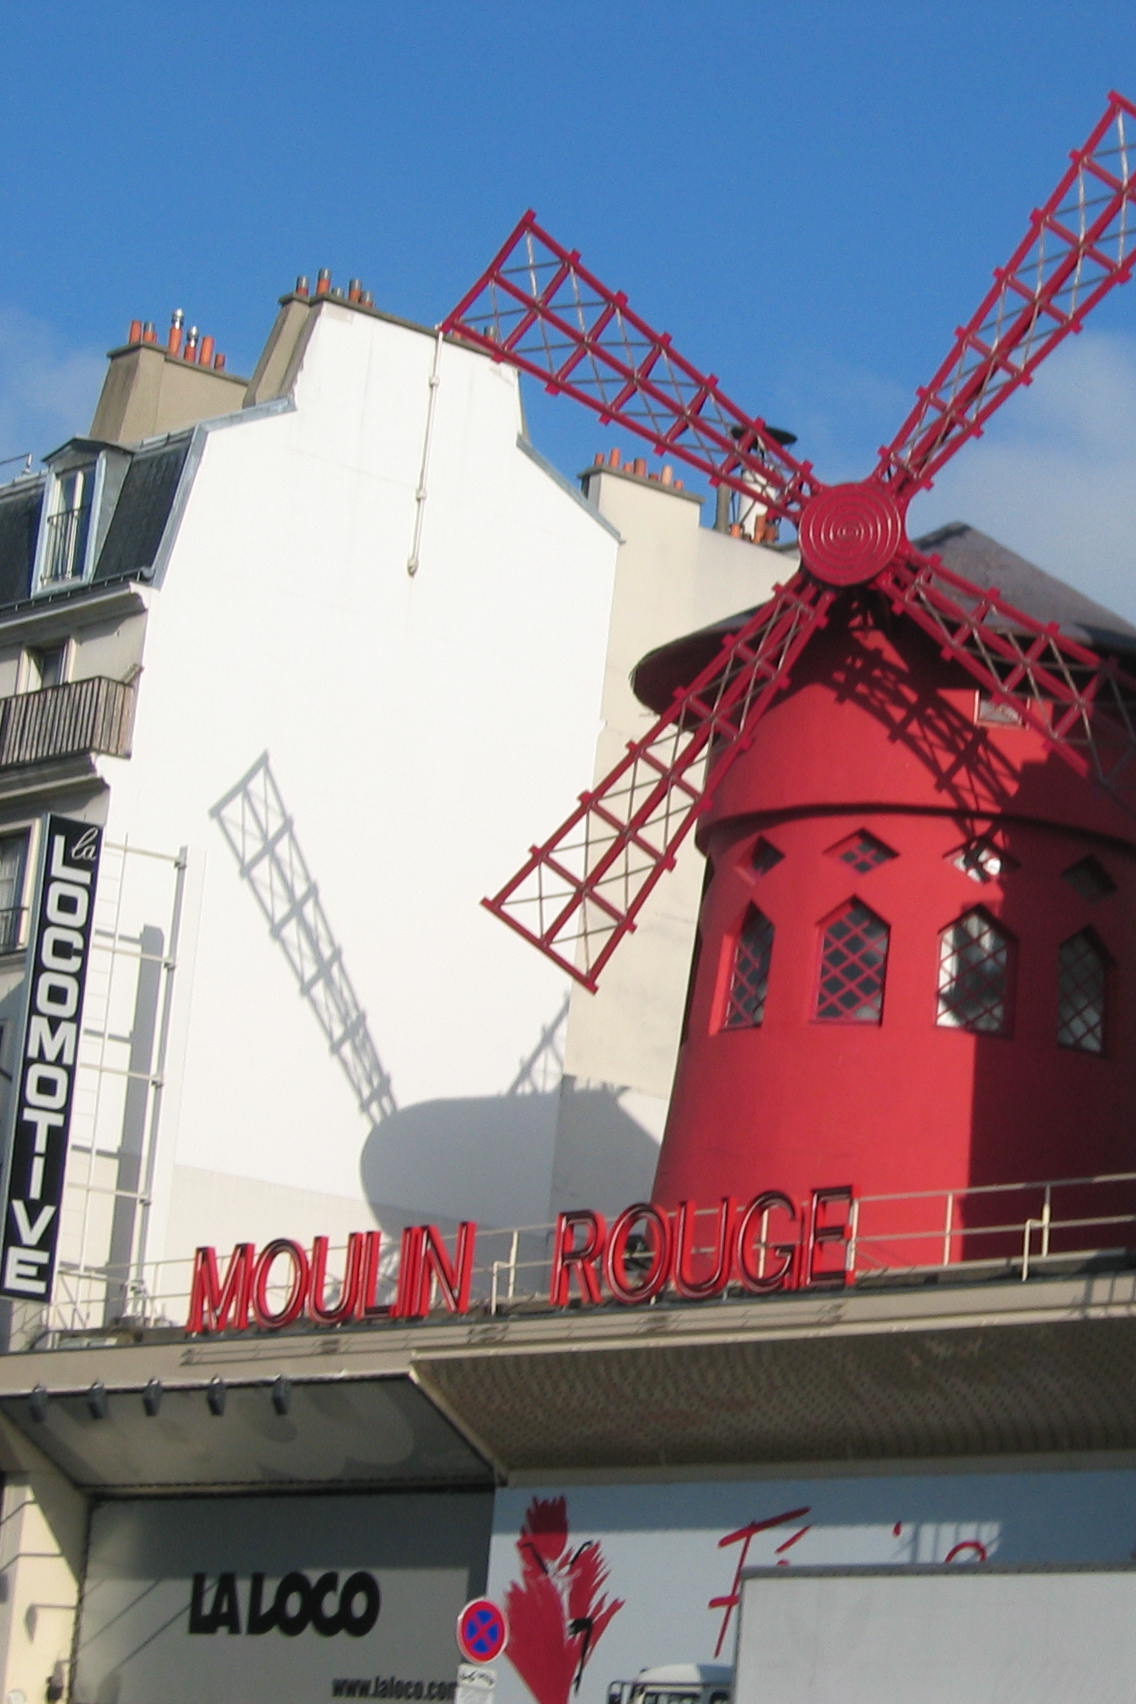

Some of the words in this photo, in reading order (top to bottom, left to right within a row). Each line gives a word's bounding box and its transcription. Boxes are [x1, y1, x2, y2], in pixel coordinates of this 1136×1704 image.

[70, 827, 98, 861] la
[3, 834, 92, 1295] LOCOMOTIVE
[185, 1221, 477, 1332] MOULIN
[550, 1184, 861, 1307] ROUGE
